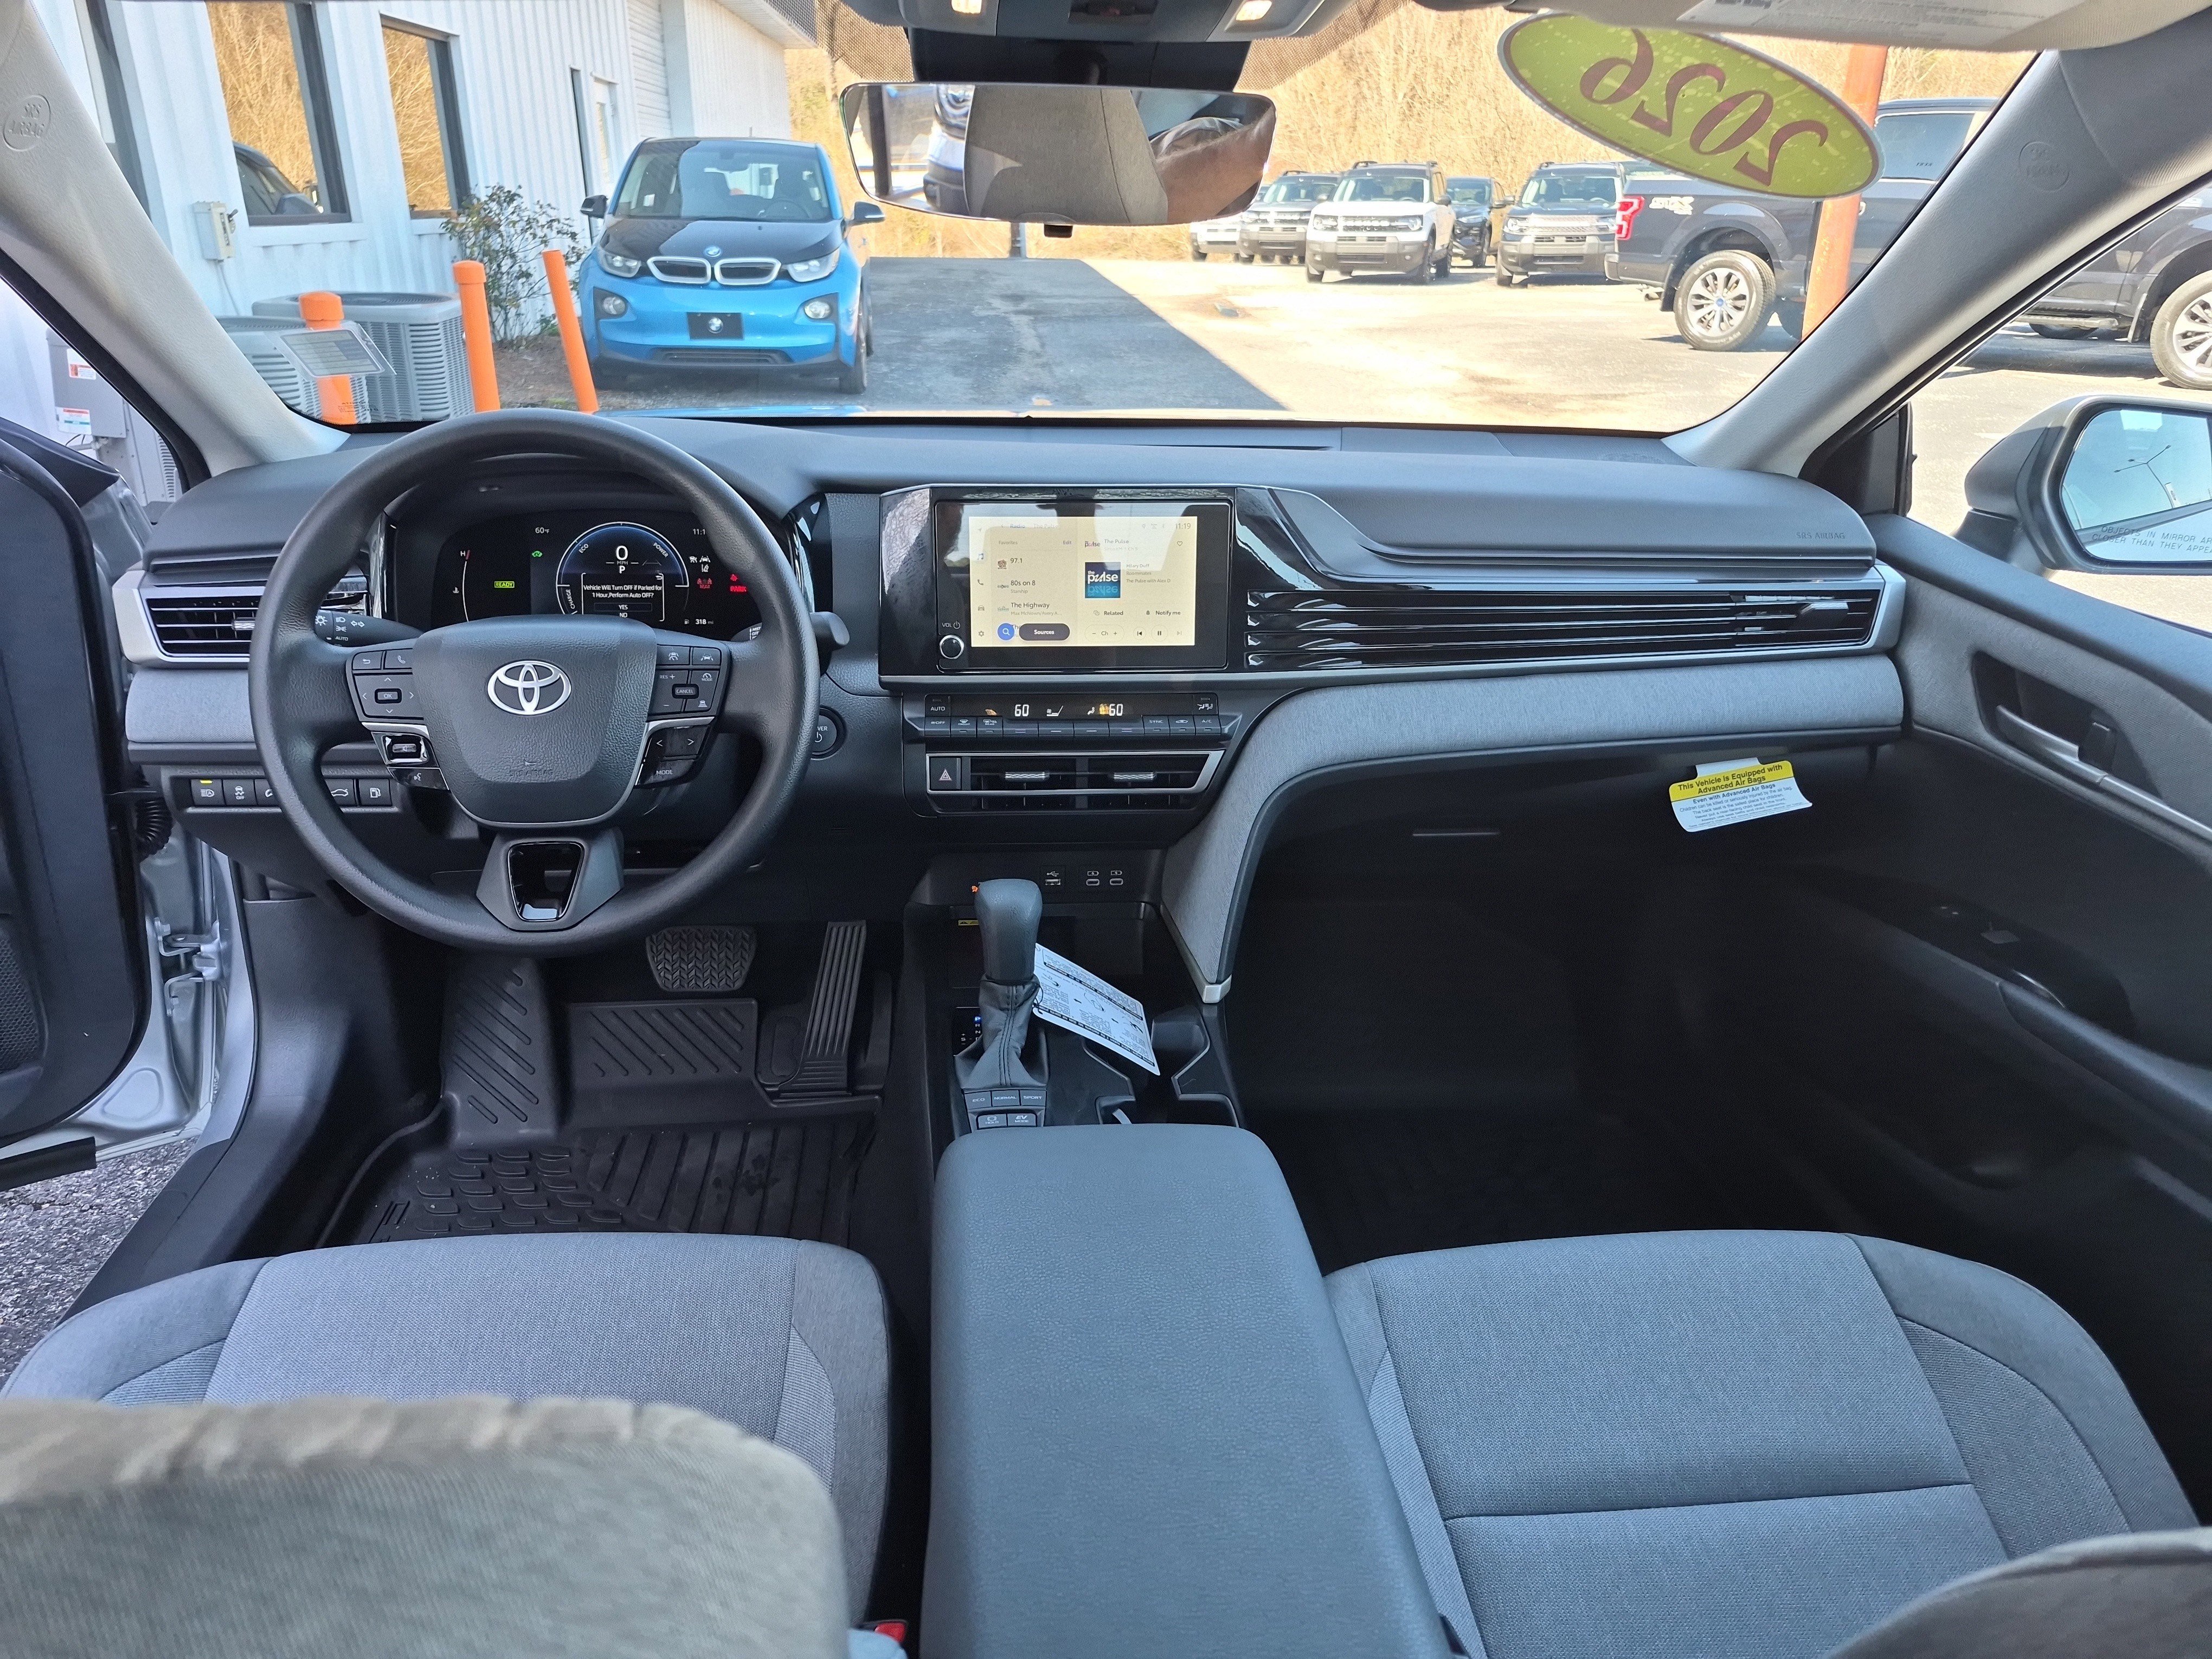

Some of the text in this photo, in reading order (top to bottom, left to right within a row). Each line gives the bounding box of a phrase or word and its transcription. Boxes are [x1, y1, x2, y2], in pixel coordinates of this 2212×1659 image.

[2092, 533, 2126, 544] CLOSER
[2132, 538, 2154, 547] THAN
[2160, 542, 2183, 550] THEY
[2101, 525, 2141, 537] OBJECTS
[2161, 532, 2196, 543] MIRROR
[578, 543, 589, 554] ECO
[615, 545, 628, 561] 0
[653, 542, 668, 558] POWER
[619, 565, 626, 574] P
[1088, 572, 1118, 584] pulse
[565, 589, 575, 609] CHARGE
[1014, 704, 1030, 717] 60
[1109, 704, 1123, 716] 60
[1677, 783, 1694, 791] This
[1695, 777, 1721, 787] Vehicle
[1732, 767, 1766, 781] Equipped
[1767, 764, 1783, 773] with
[1697, 781, 1734, 795] Advanced
[1747, 776, 1766, 784] Bags
[1722, 788, 1750, 798] Advanced
